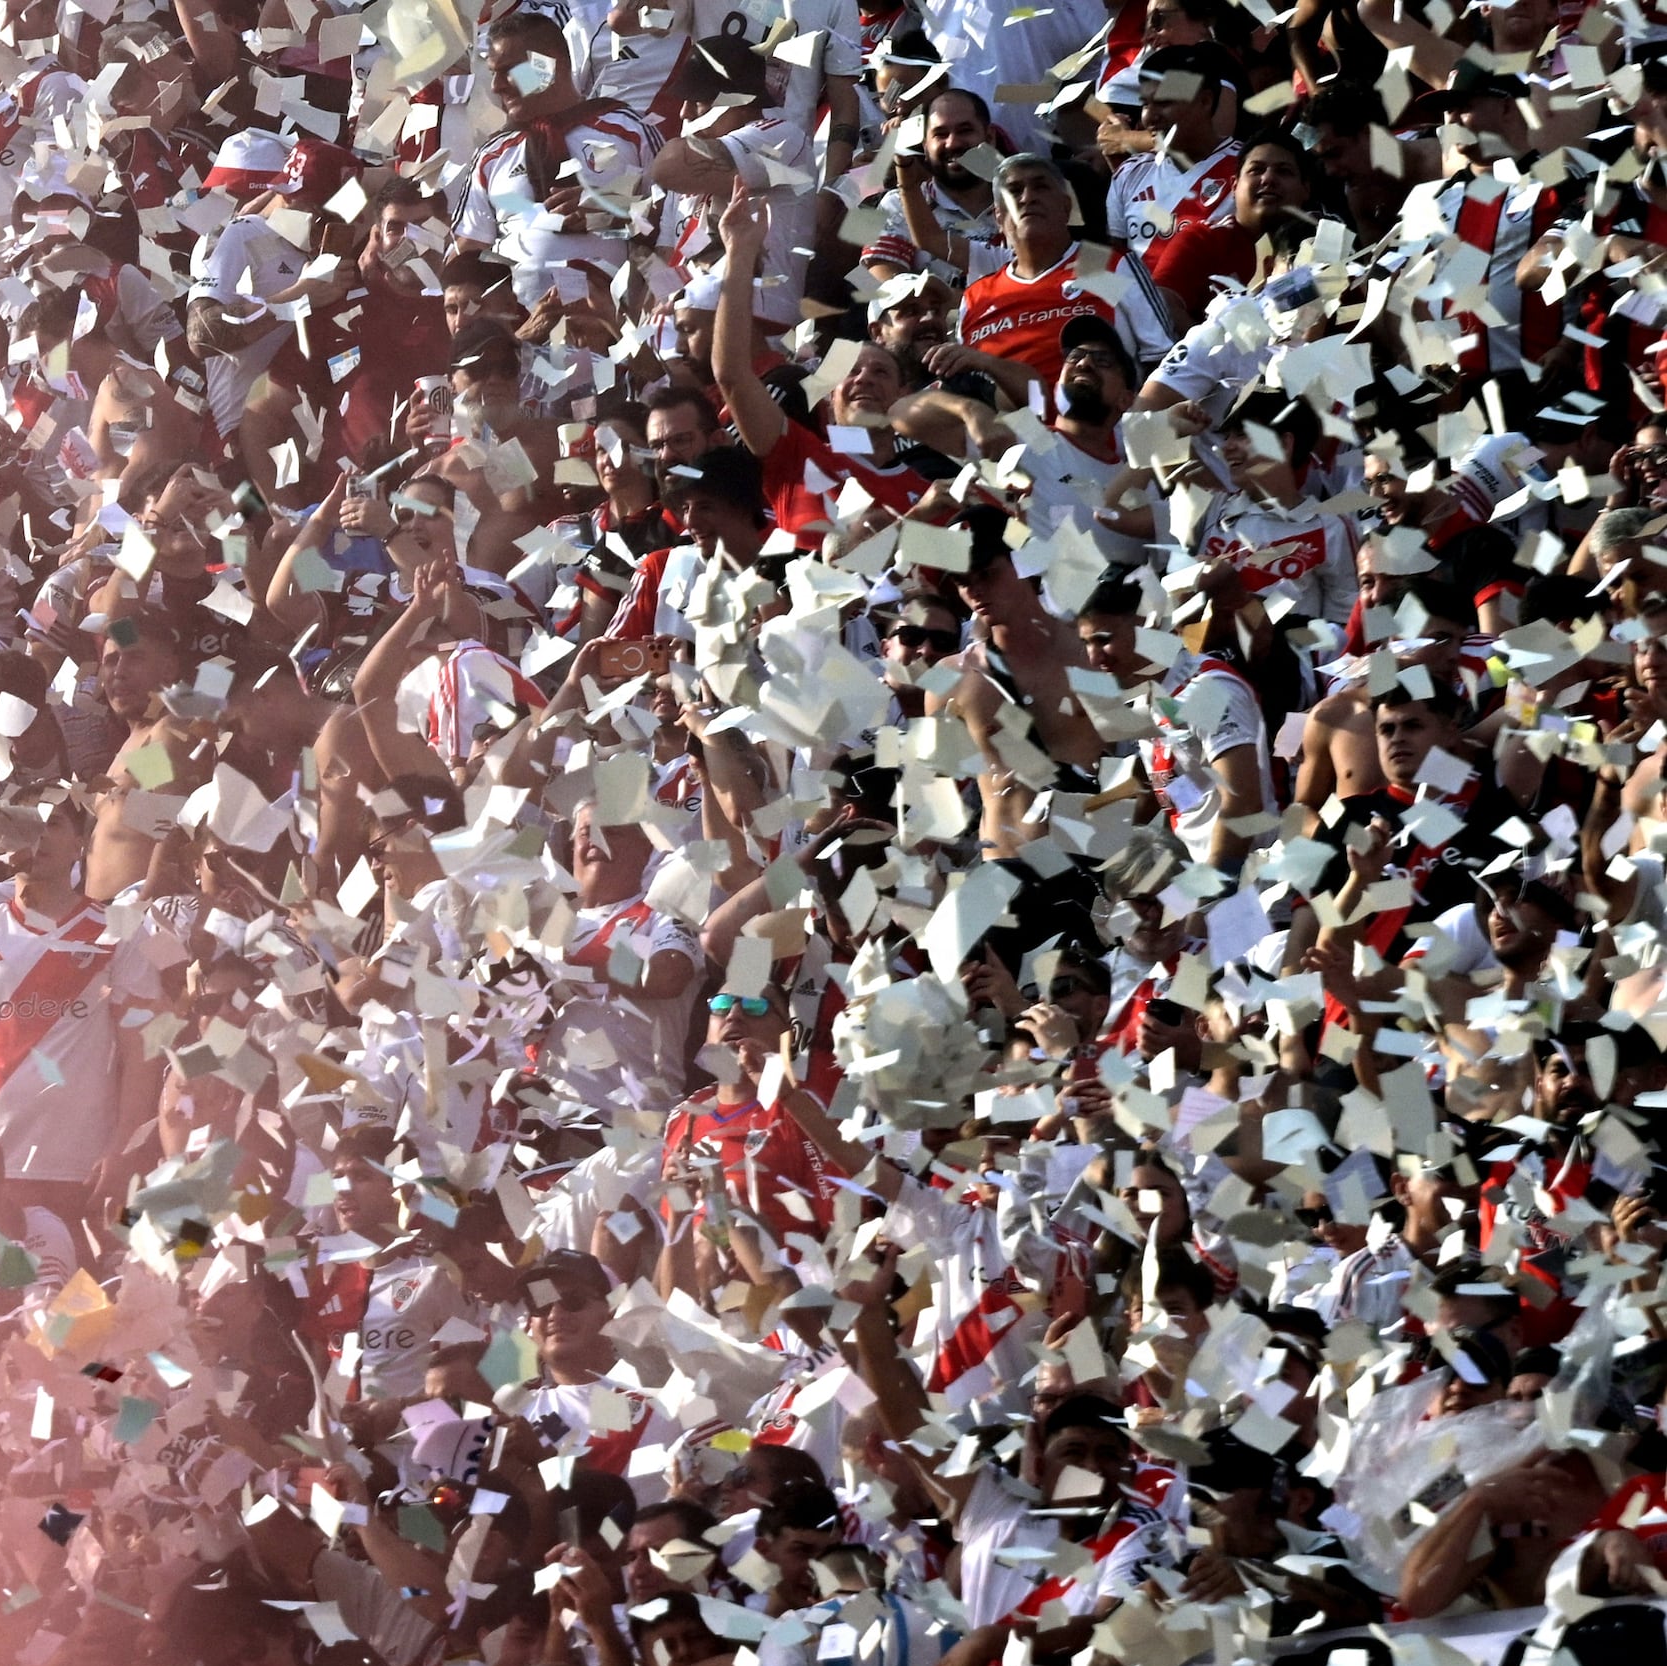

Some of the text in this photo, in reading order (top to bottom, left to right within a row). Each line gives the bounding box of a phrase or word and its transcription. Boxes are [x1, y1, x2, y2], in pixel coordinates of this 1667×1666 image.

[282, 147, 307, 178] 23
[969, 301, 1095, 345] BBVA Francés
